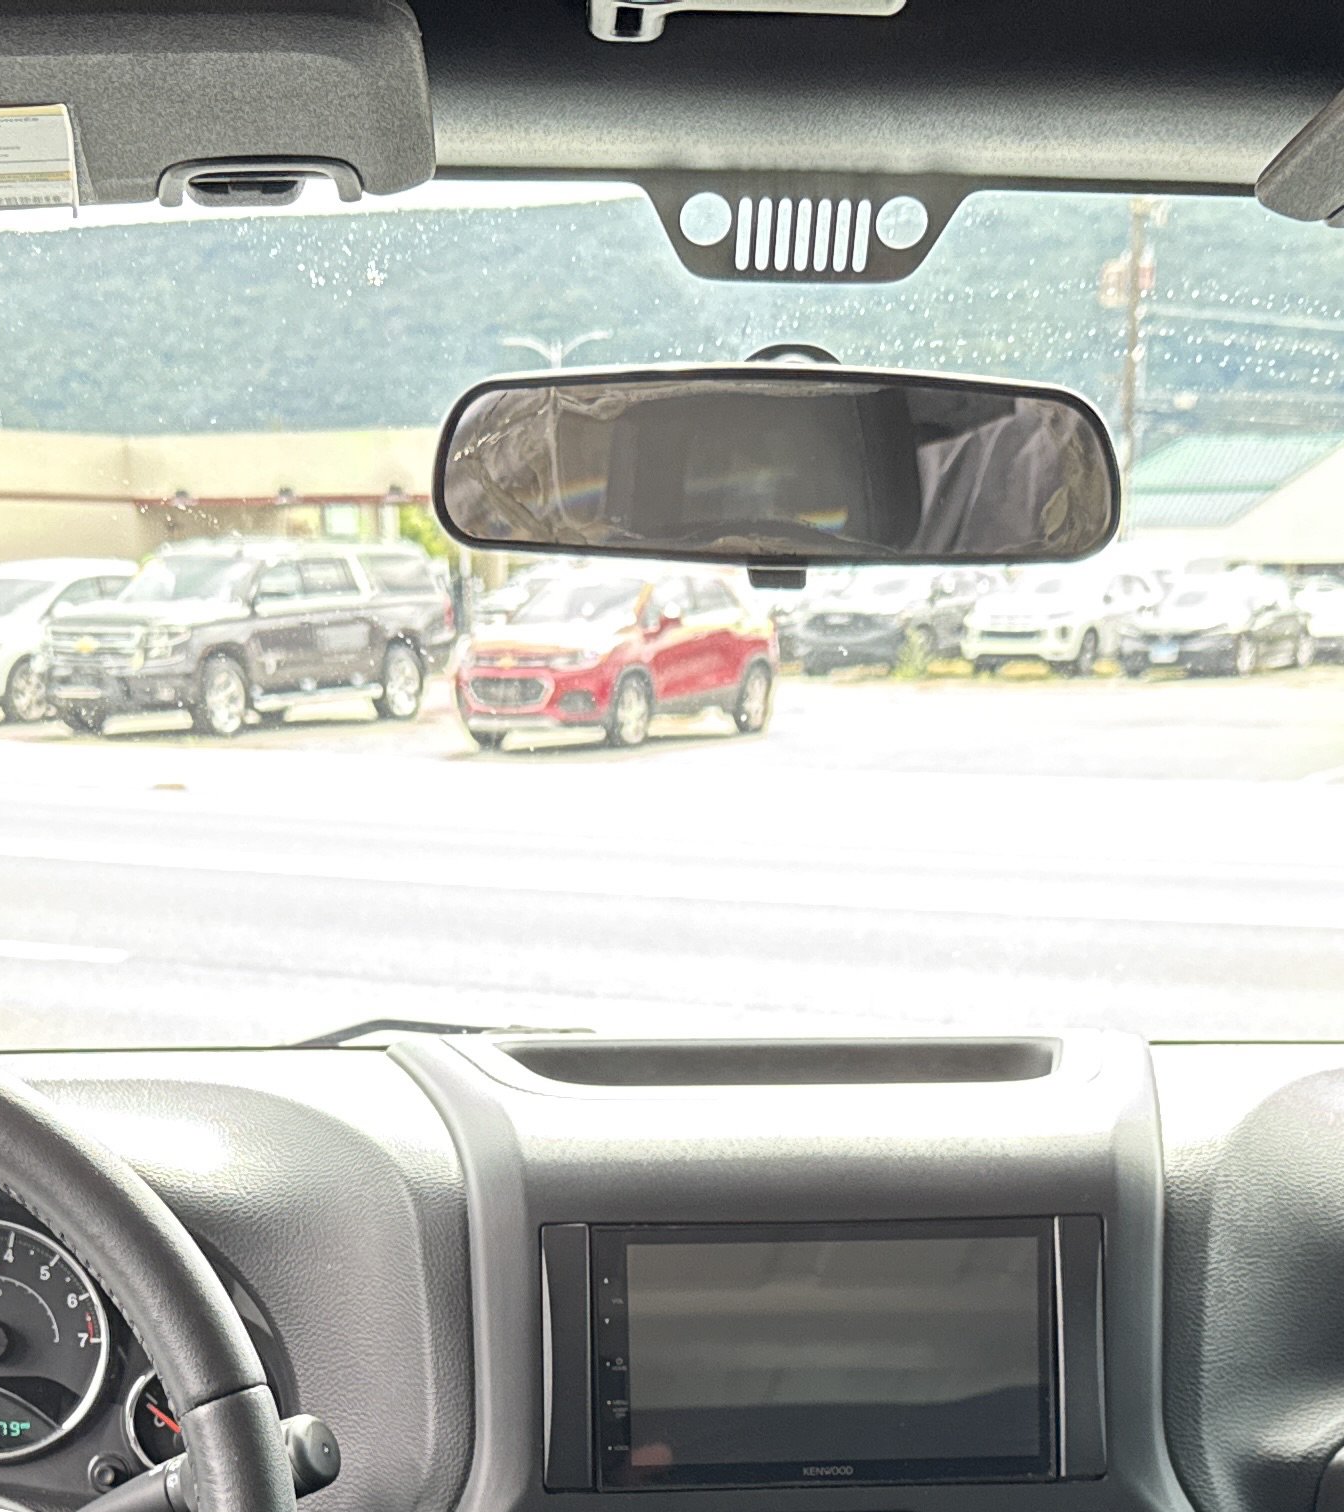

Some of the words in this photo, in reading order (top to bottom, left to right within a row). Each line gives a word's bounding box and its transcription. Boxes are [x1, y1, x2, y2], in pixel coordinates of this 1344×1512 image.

[3, 1249, 14, 1263] 4
[40, 1266, 51, 1281] 5
[67, 1293, 78, 1309] 6
[78, 1333, 89, 1348] 7
[802, 1465, 854, 1477] KENWOOD
